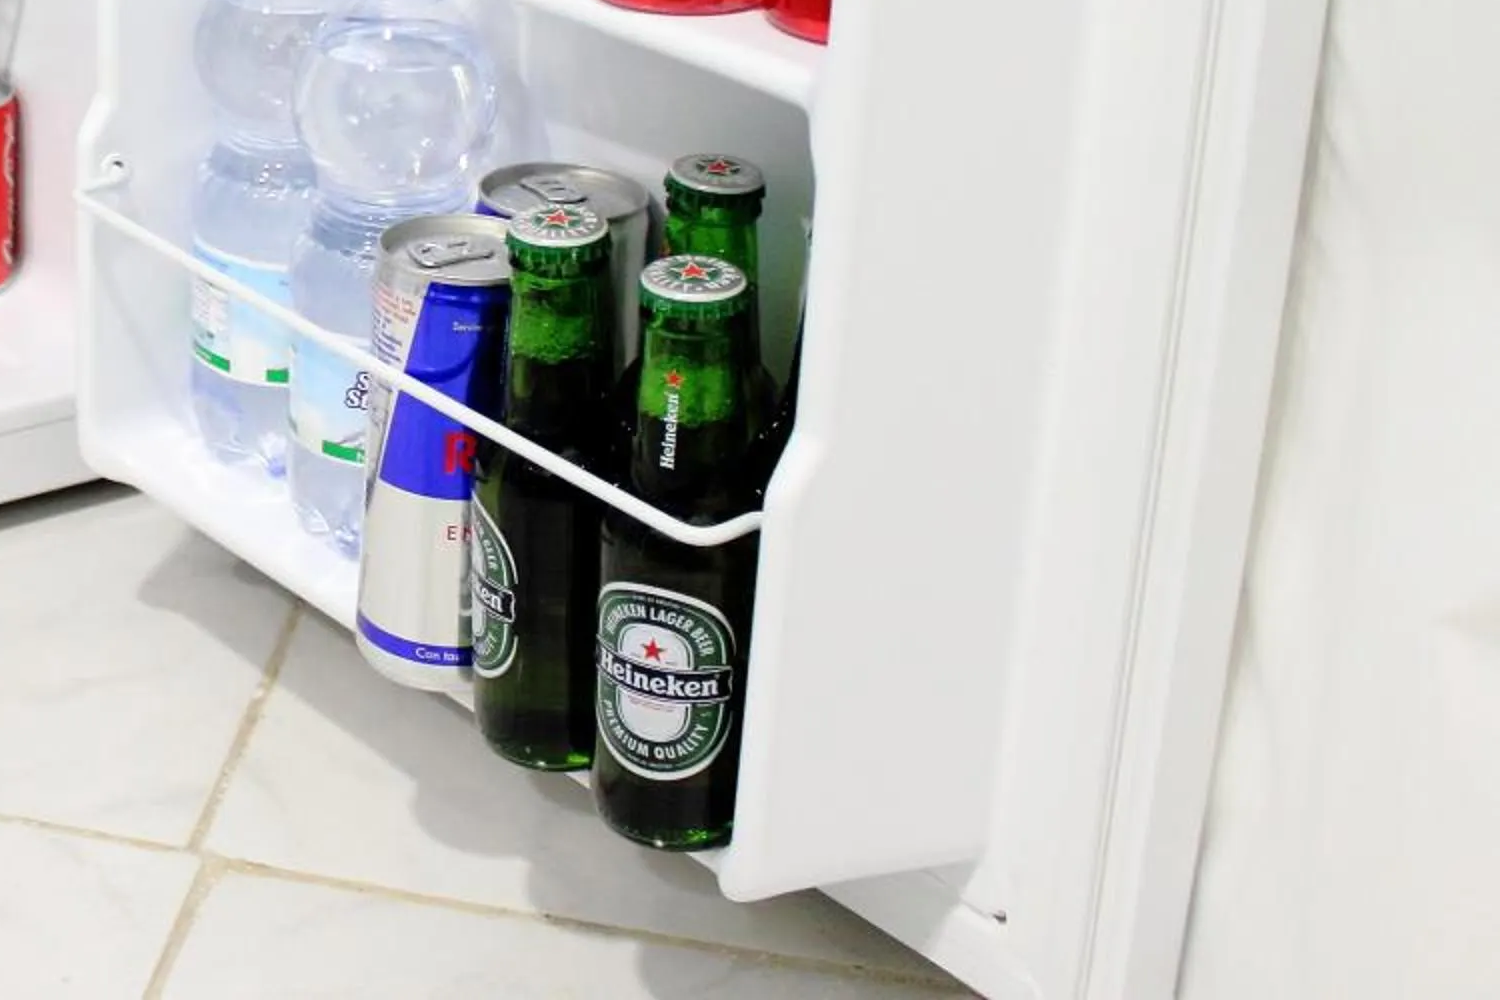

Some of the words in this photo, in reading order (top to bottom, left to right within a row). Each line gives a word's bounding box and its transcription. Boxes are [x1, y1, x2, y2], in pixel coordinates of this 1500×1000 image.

[659, 392, 680, 470] Heineken
[650, 607, 694, 633] LAGER
[600, 648, 720, 698] Heineken
[653, 722, 709, 760] QUALITY
